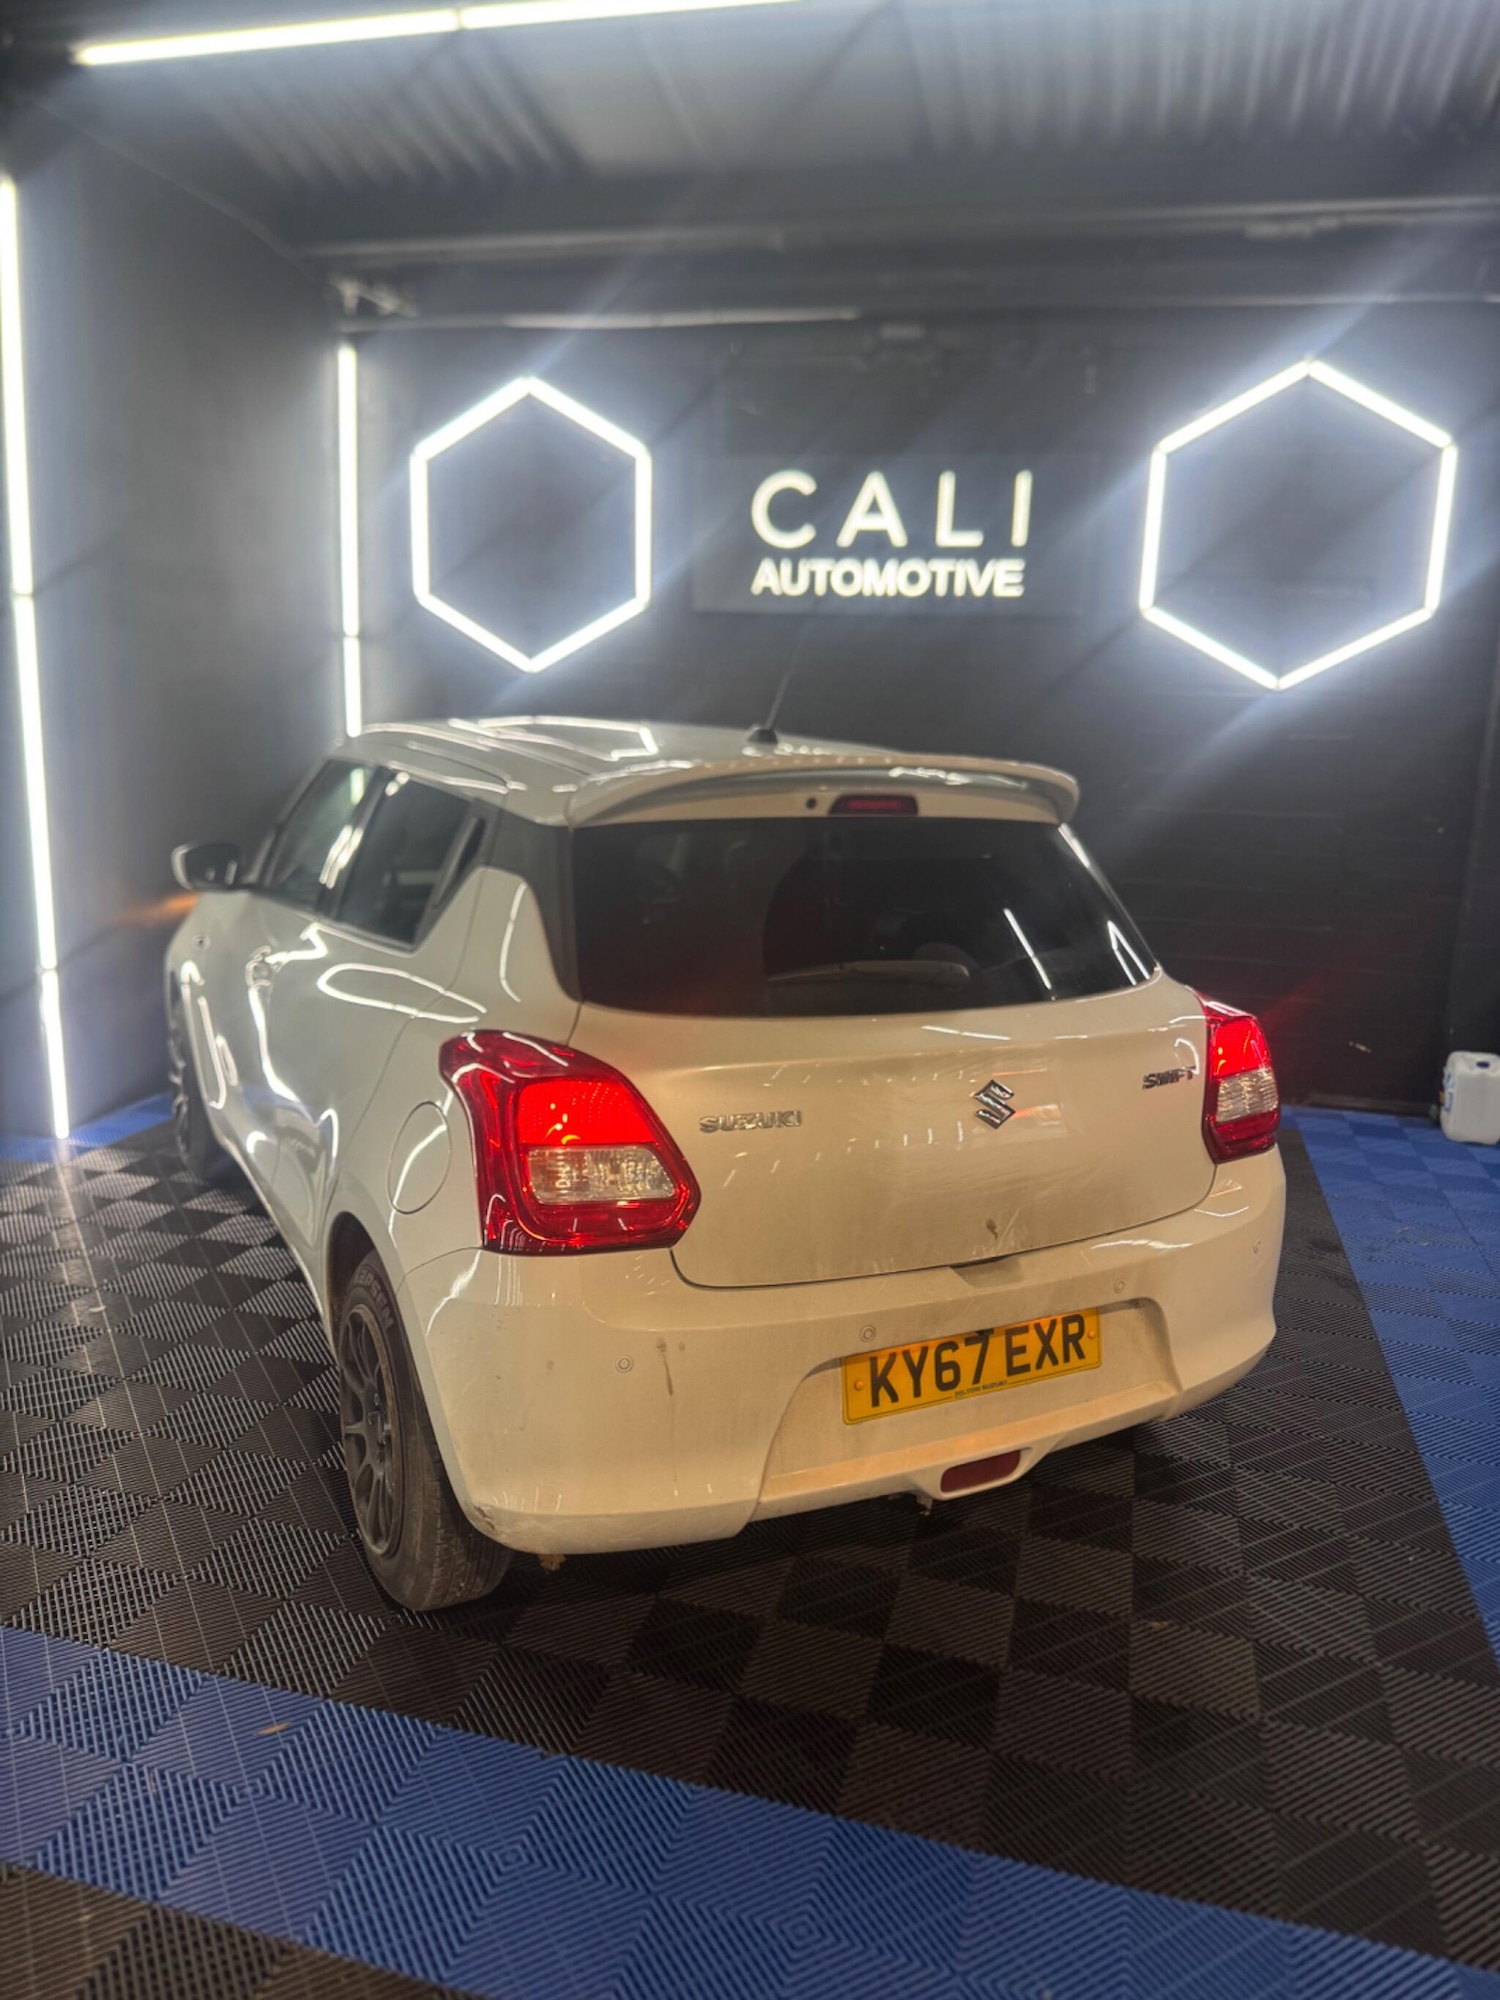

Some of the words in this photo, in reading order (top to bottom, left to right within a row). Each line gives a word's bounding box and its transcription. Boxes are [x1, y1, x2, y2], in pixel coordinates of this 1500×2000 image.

[751, 470, 1033, 549] CALI
[751, 558, 1025, 597] AUTOMOTIVE
[699, 1110, 802, 1133] SUZUKI
[869, 1334, 990, 1407] KY67
[1005, 1313, 1085, 1377] EXR
